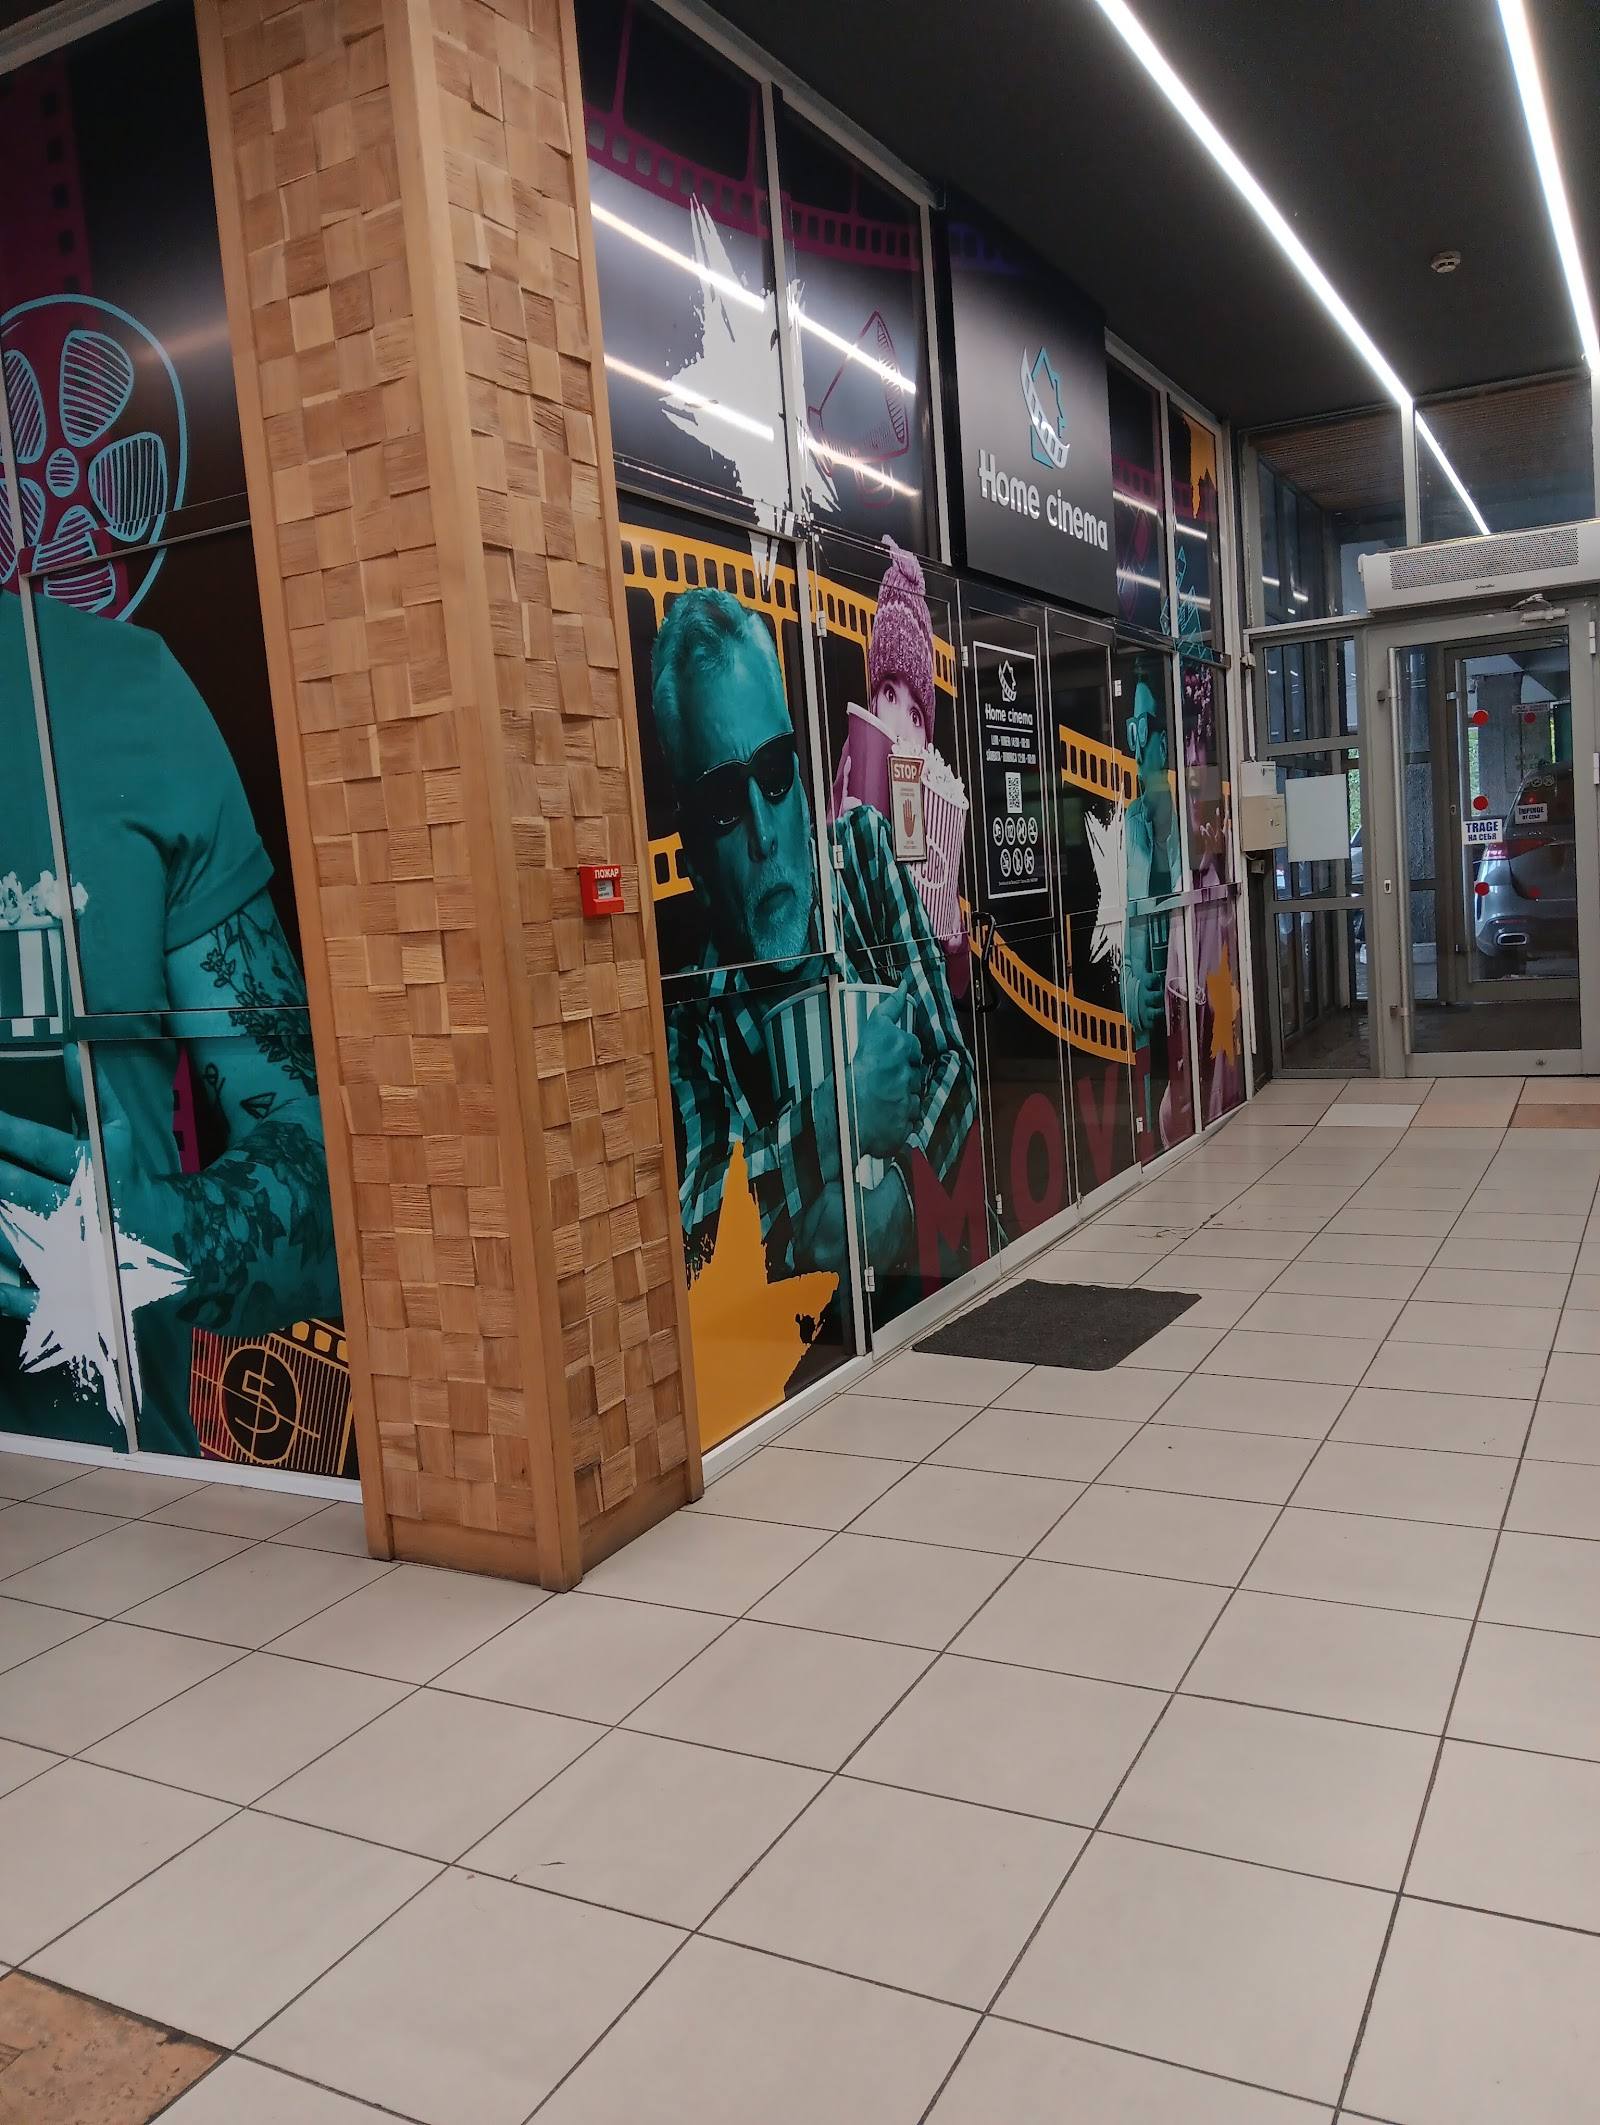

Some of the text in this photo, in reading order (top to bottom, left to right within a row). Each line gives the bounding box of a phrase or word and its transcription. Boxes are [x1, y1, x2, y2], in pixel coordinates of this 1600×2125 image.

[978, 449, 1109, 551] Home cinema
[985, 703, 1034, 725] Home cinema
[893, 763, 918, 780] STOP
[1465, 821, 1499, 833] TRAGE
[1478, 832, 1497, 841] СЕБЯ
[594, 868, 619, 879] ПОЖАР
[235, 1369, 280, 1434] 5
